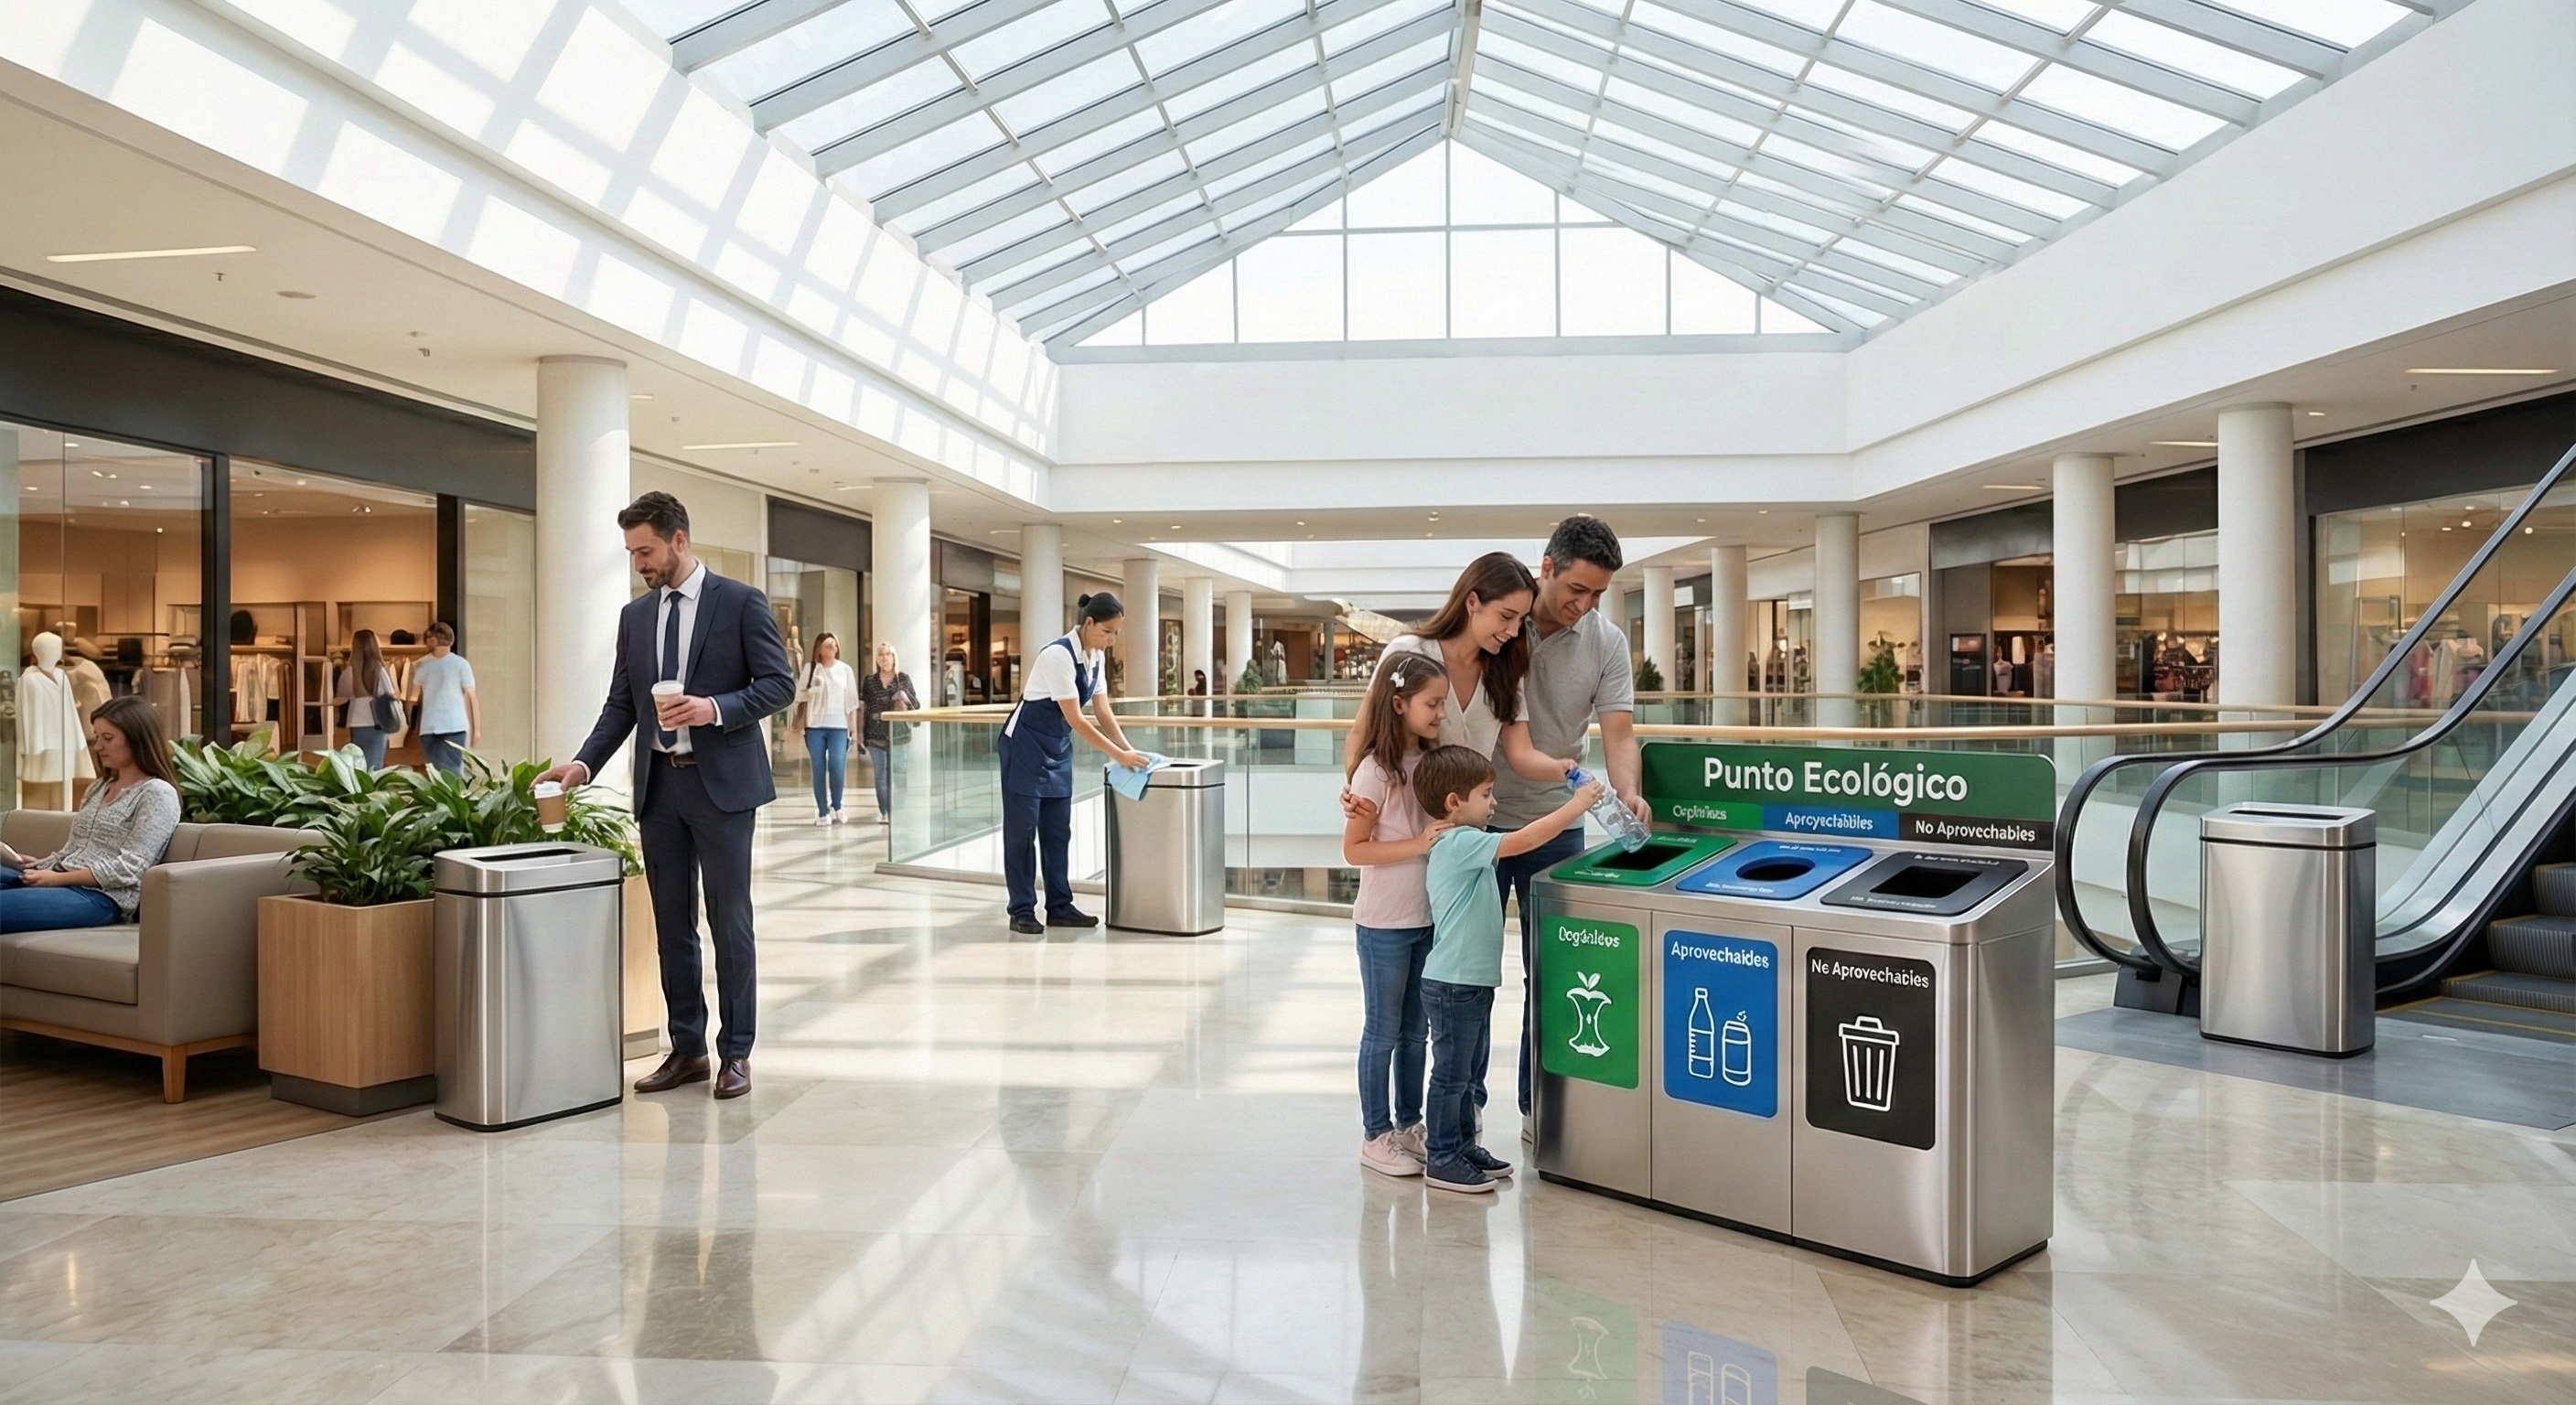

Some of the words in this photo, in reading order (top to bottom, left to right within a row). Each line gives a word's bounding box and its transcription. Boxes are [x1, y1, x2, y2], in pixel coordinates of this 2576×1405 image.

[1704, 756, 1794, 792] Punto
[1804, 761, 1968, 807] Ecológico
[1916, 820, 1934, 834] No
